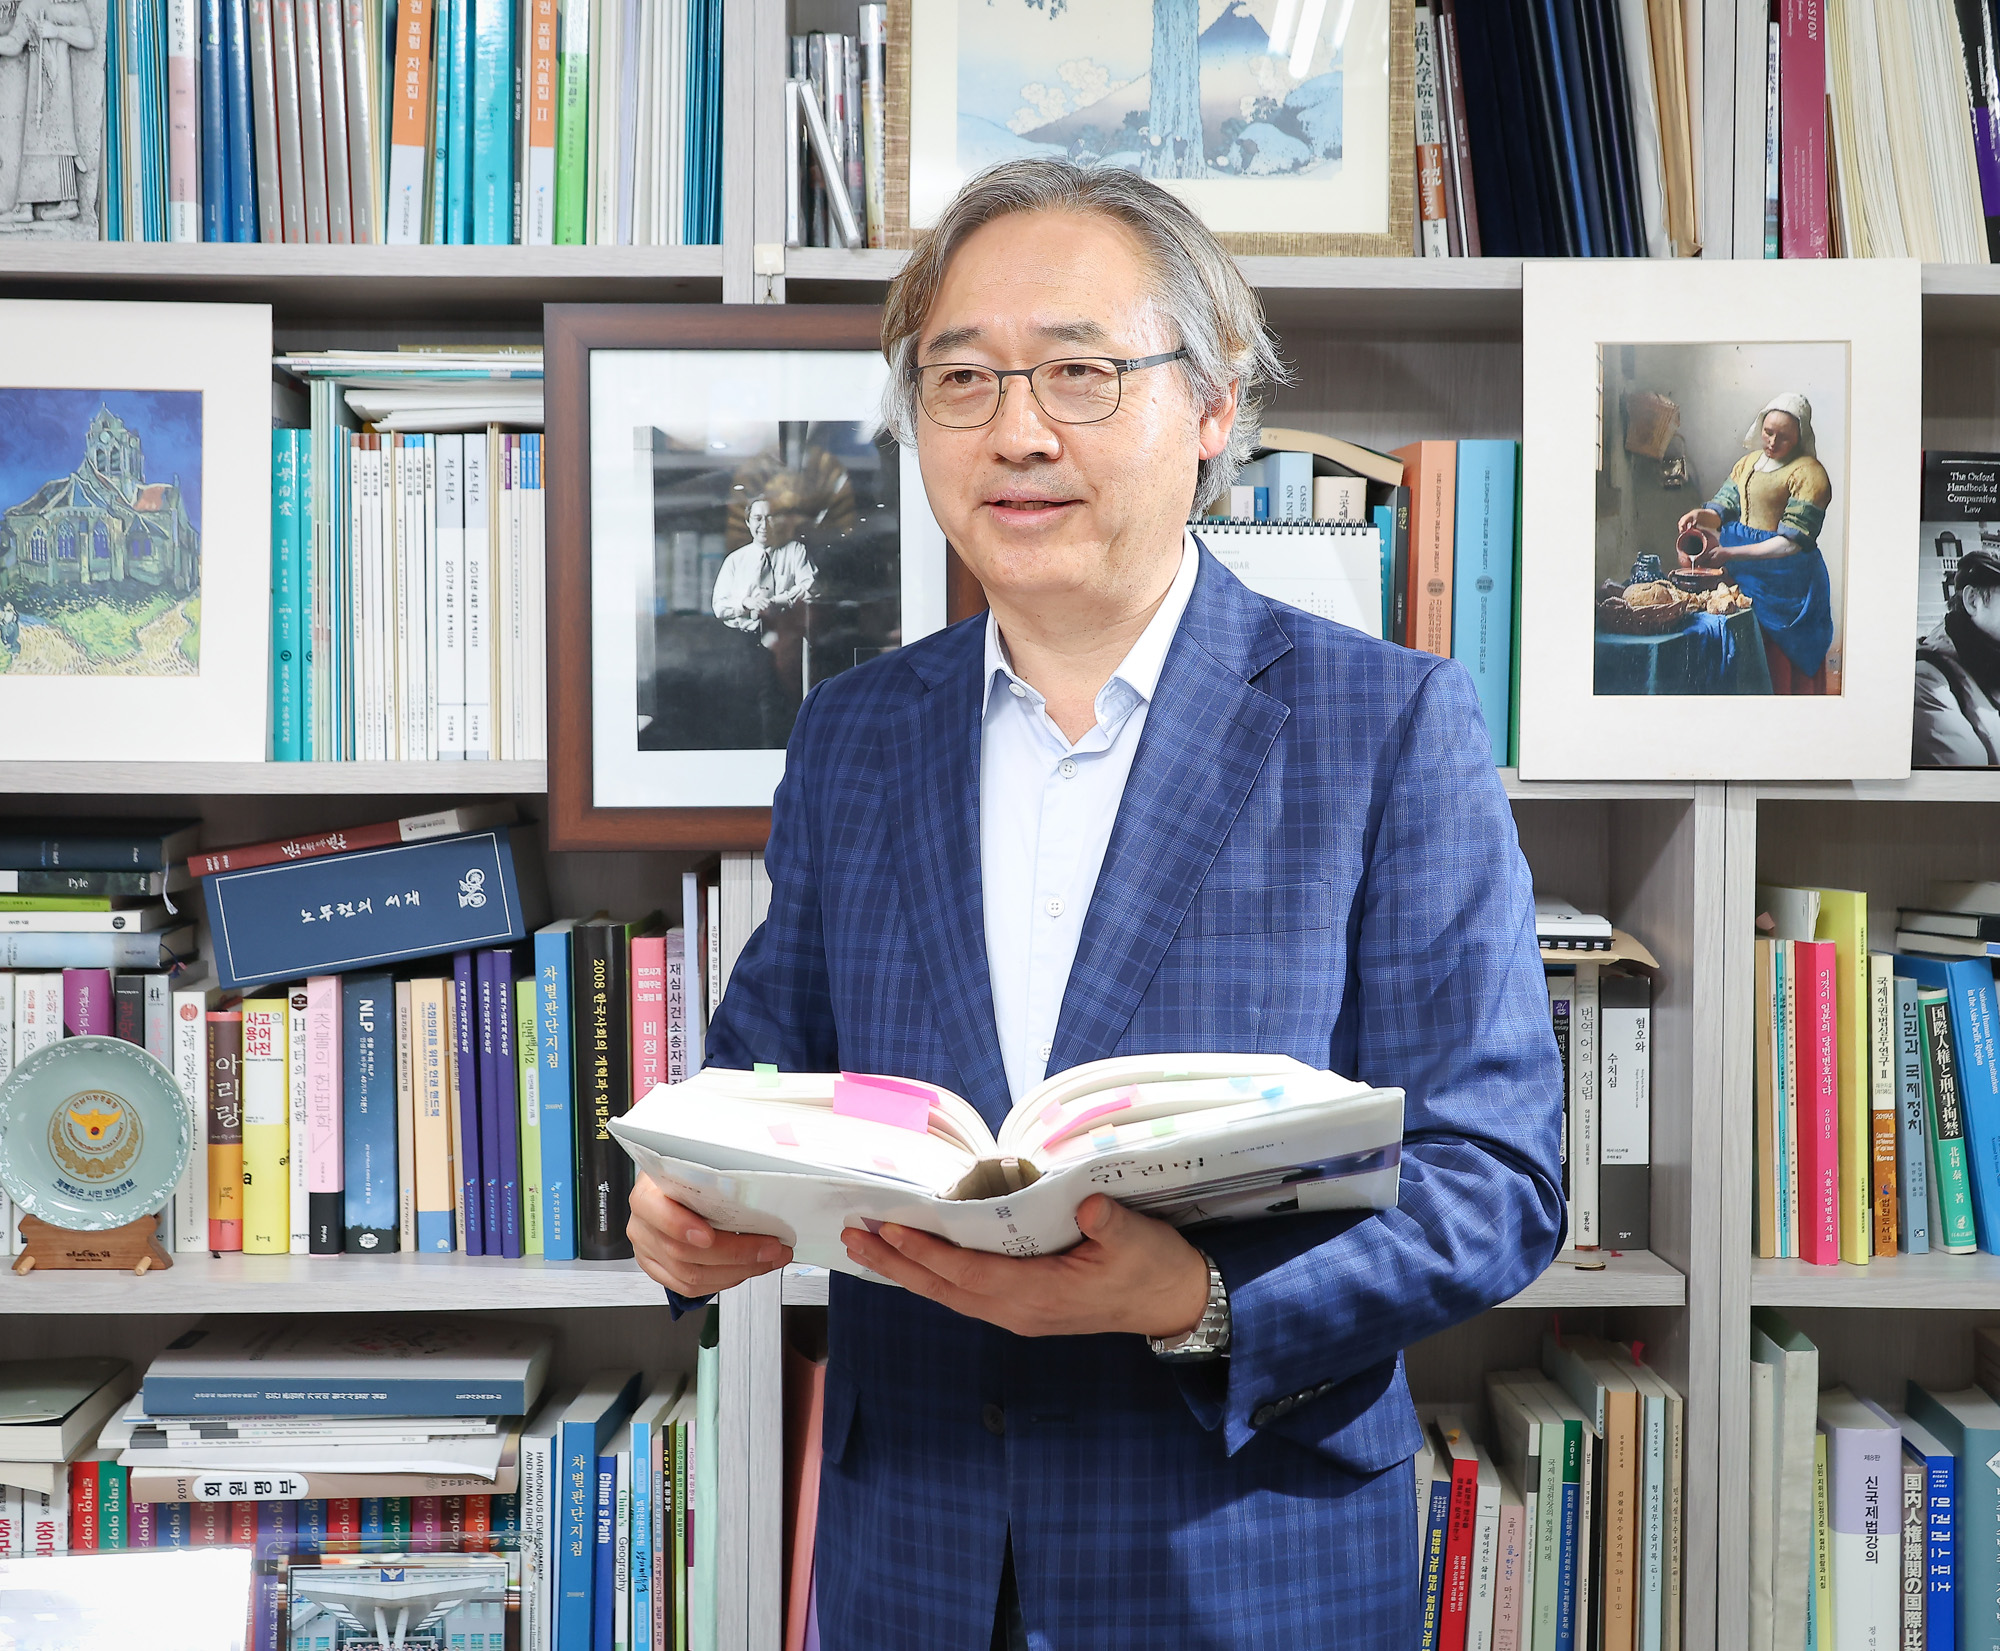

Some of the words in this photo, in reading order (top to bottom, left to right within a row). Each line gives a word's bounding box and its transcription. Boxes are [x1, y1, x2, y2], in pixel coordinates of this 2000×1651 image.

[406, 57, 420, 99] 자료집
[537, 59, 550, 100] 자료집
[1415, 22, 1435, 142] 法科大学院と臨床法
[1430, 148, 1441, 186] リーガル
[1286, 485, 1294, 497] ON
[1947, 483, 1988, 493] Handbook
[1989, 484, 1998, 493] of
[1950, 472, 1966, 481] The
[1967, 472, 1995, 482] Oxford
[1299, 485, 1307, 512] CASES
[1947, 494, 1997, 505] Comparative
[1964, 505, 1982, 514] Law
[68, 877, 89, 890] Pyle
[300, 897, 374, 924] 노무현의
[385, 889, 421, 908] 서재
[593, 959, 605, 989] 2008
[1820, 970, 1831, 1000] 이것이
[1967, 989, 1976, 997] in
[1968, 996, 1977, 1007] the
[1979, 987, 1989, 1015] National
[246, 1012, 284, 1026] 사고의
[359, 1000, 375, 1032] NLP
[428, 1002, 438, 1045] 국회의원을
[543, 965, 559, 1068] 차별판단지침
[594, 993, 608, 1050] 한국사회의
[1821, 1002, 1832, 1033] 일본의
[1877, 976, 1891, 1067] 국제인권법실무연구
[1903, 1002, 1918, 1056] 인권과
[1969, 1006, 1982, 1044] Asia-Pacific
[1982, 1014, 1991, 1039] Human
[246, 1027, 271, 1041] 용어
[246, 1042, 271, 1056] 사전
[1581, 1006, 1594, 1064] 번역어의
[1634, 1017, 1646, 1053] 혐오와
[1984, 1039, 1994, 1059] Rights
[429, 1050, 438, 1067] 위한
[1821, 1036, 1833, 1096] 당번변호사다
[1974, 1043, 1984, 1066] Region
[430, 1070, 439, 1087] 인권
[595, 1055, 609, 1090] 개혁과
[1580, 1070, 1594, 1101] 성립
[1607, 1053, 1619, 1089] 수치심
[1931, 1005, 1959, 1137] 国際人権と刑事拘禁
[1988, 1058, 1999, 1095] Institutions
[216, 1054, 243, 1128] 아리랑
[430, 1091, 440, 1117] 핸드북
[1905, 1064, 1922, 1136] 국제정치
[596, 1094, 610, 1140] 입법과제
[1824, 1108, 1832, 1139] 2003
[1823, 1169, 1834, 1242] 서울지방변호사회
[525, 1451, 533, 1470] AND
[1863, 1454, 1881, 1462] 제8판
[78, 1478, 93, 1512] 로마인
[104, 1478, 120, 1512] 로마인
[178, 1478, 188, 1500] 2011
[204, 1479, 297, 1496] 회원명부
[525, 1472, 533, 1505] HUMAN
[535, 1451, 544, 1513] HARMONIOUS
[570, 1454, 586, 1557] 차별판단지침
[618, 1489, 627, 1527] China's
[1865, 1475, 1879, 1565] 신국제법강의
[598, 1518, 612, 1544] Path
[1431, 1529, 1443, 1554] 평화로
[1481, 1526, 1492, 1563] 균형이라는
[615, 1536, 629, 1592] Geography
[1429, 1555, 1440, 1572] 가는
[1480, 1565, 1489, 1581] 삶의
[1904, 1473, 1923, 1651] 国内人権機関の国際比
[1478, 1584, 1487, 1598] 기술
[1424, 1594, 1436, 1628] 제국으로
[1421, 1630, 1433, 1647] 가는
[1868, 1626, 1877, 1651] 정인
